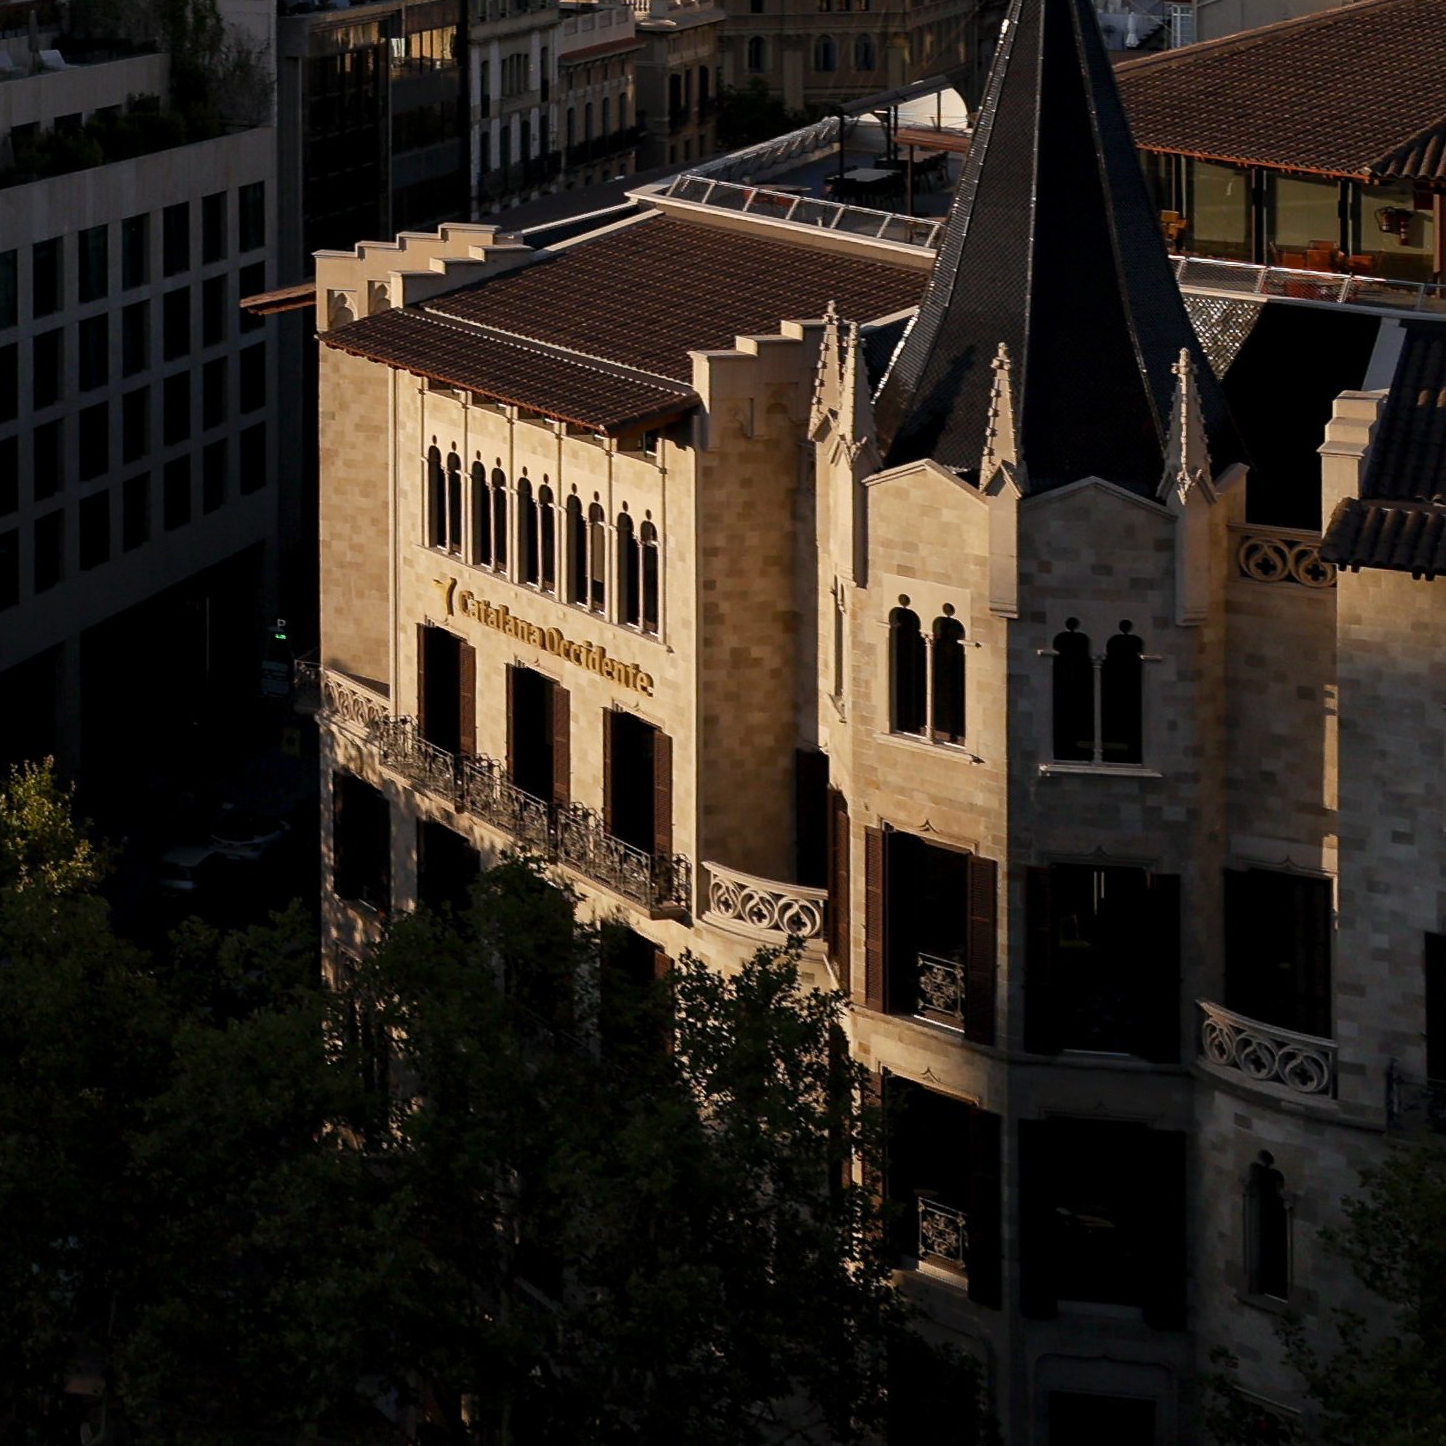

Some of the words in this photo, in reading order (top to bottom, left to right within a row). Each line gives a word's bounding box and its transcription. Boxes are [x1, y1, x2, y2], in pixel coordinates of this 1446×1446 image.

[276, 618, 287, 631] P
[459, 590, 547, 651] Catalana
[546, 626, 654, 698] Occidente
